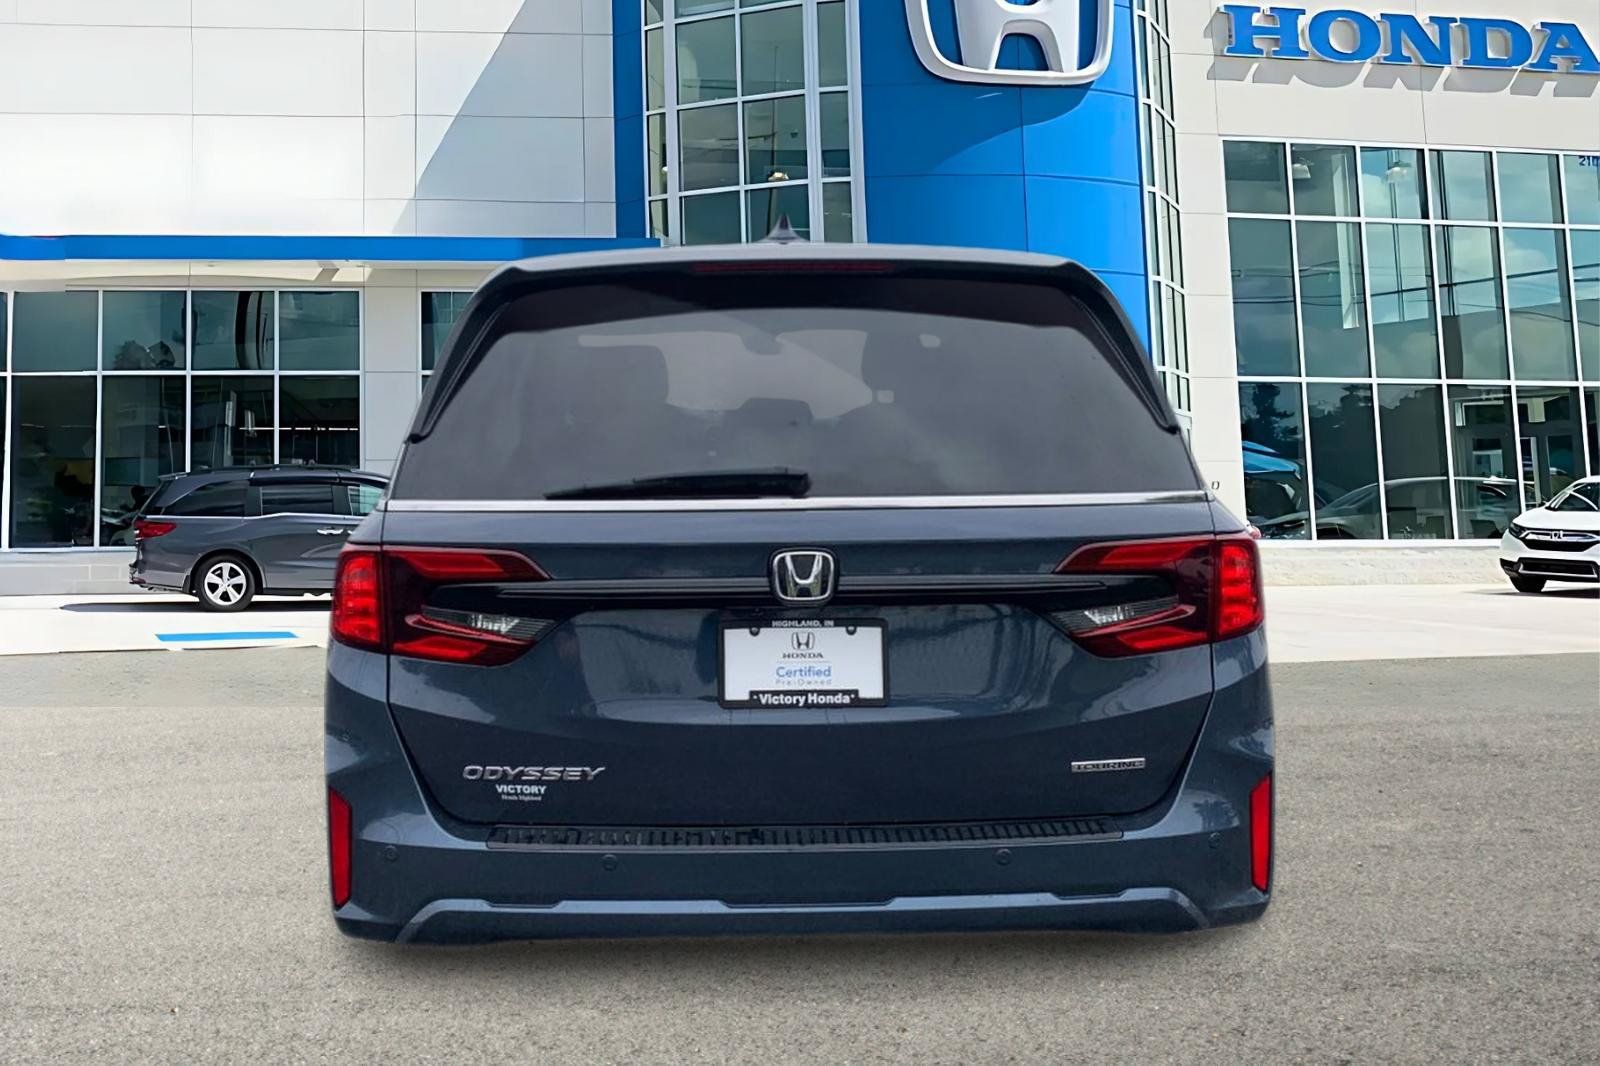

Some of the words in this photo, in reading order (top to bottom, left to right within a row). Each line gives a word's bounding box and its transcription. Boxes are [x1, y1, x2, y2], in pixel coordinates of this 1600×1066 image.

[1222, 3, 1600, 73] HONDA
[776, 666, 831, 677] Certified
[759, 693, 806, 706] Victory
[808, 692, 850, 704] Honda
[1074, 760, 1144, 771] TOURING
[462, 765, 606, 780] ODYSSEY
[495, 784, 547, 794] VICTORY
